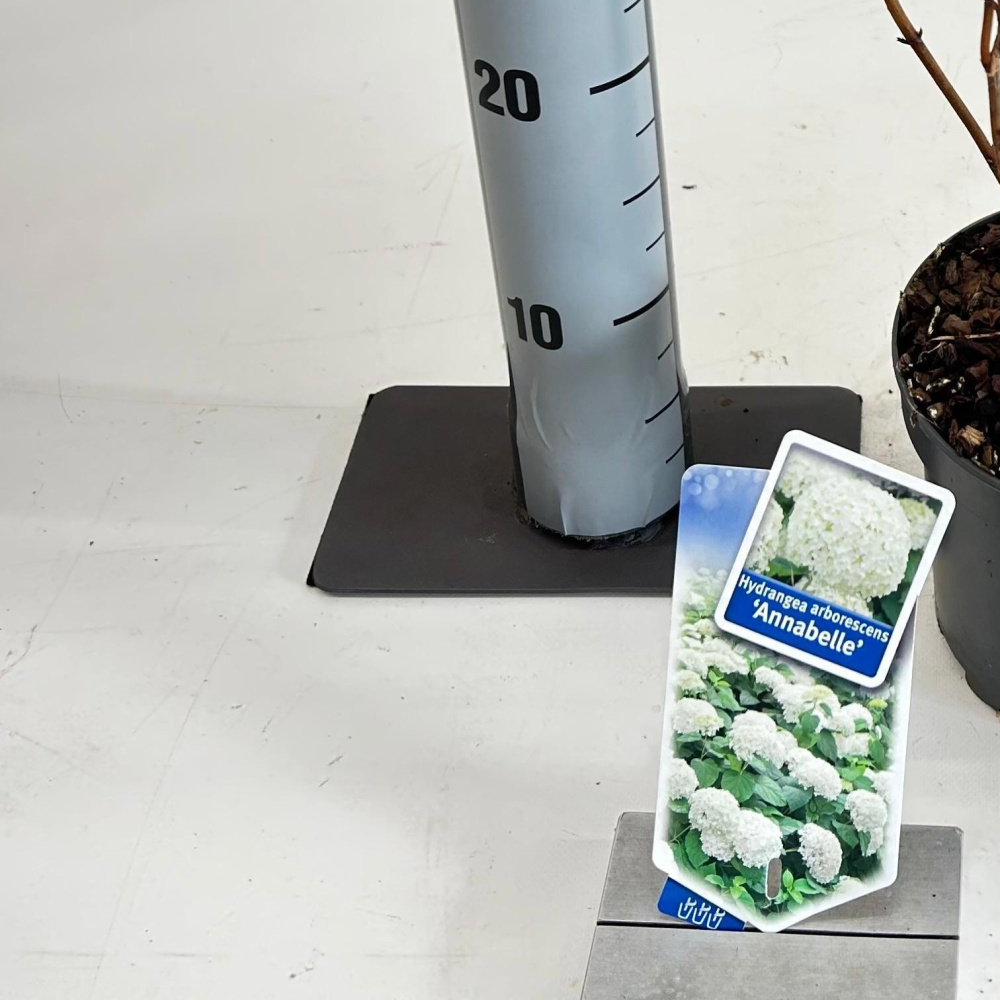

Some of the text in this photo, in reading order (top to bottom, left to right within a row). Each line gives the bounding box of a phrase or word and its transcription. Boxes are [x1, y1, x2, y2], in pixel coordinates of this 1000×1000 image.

[474, 59, 541, 123] 20
[507, 297, 563, 350] 10
[738, 573, 890, 643] Hydrangea arborescens
[752, 599, 864, 656] ‘Annabelle’
